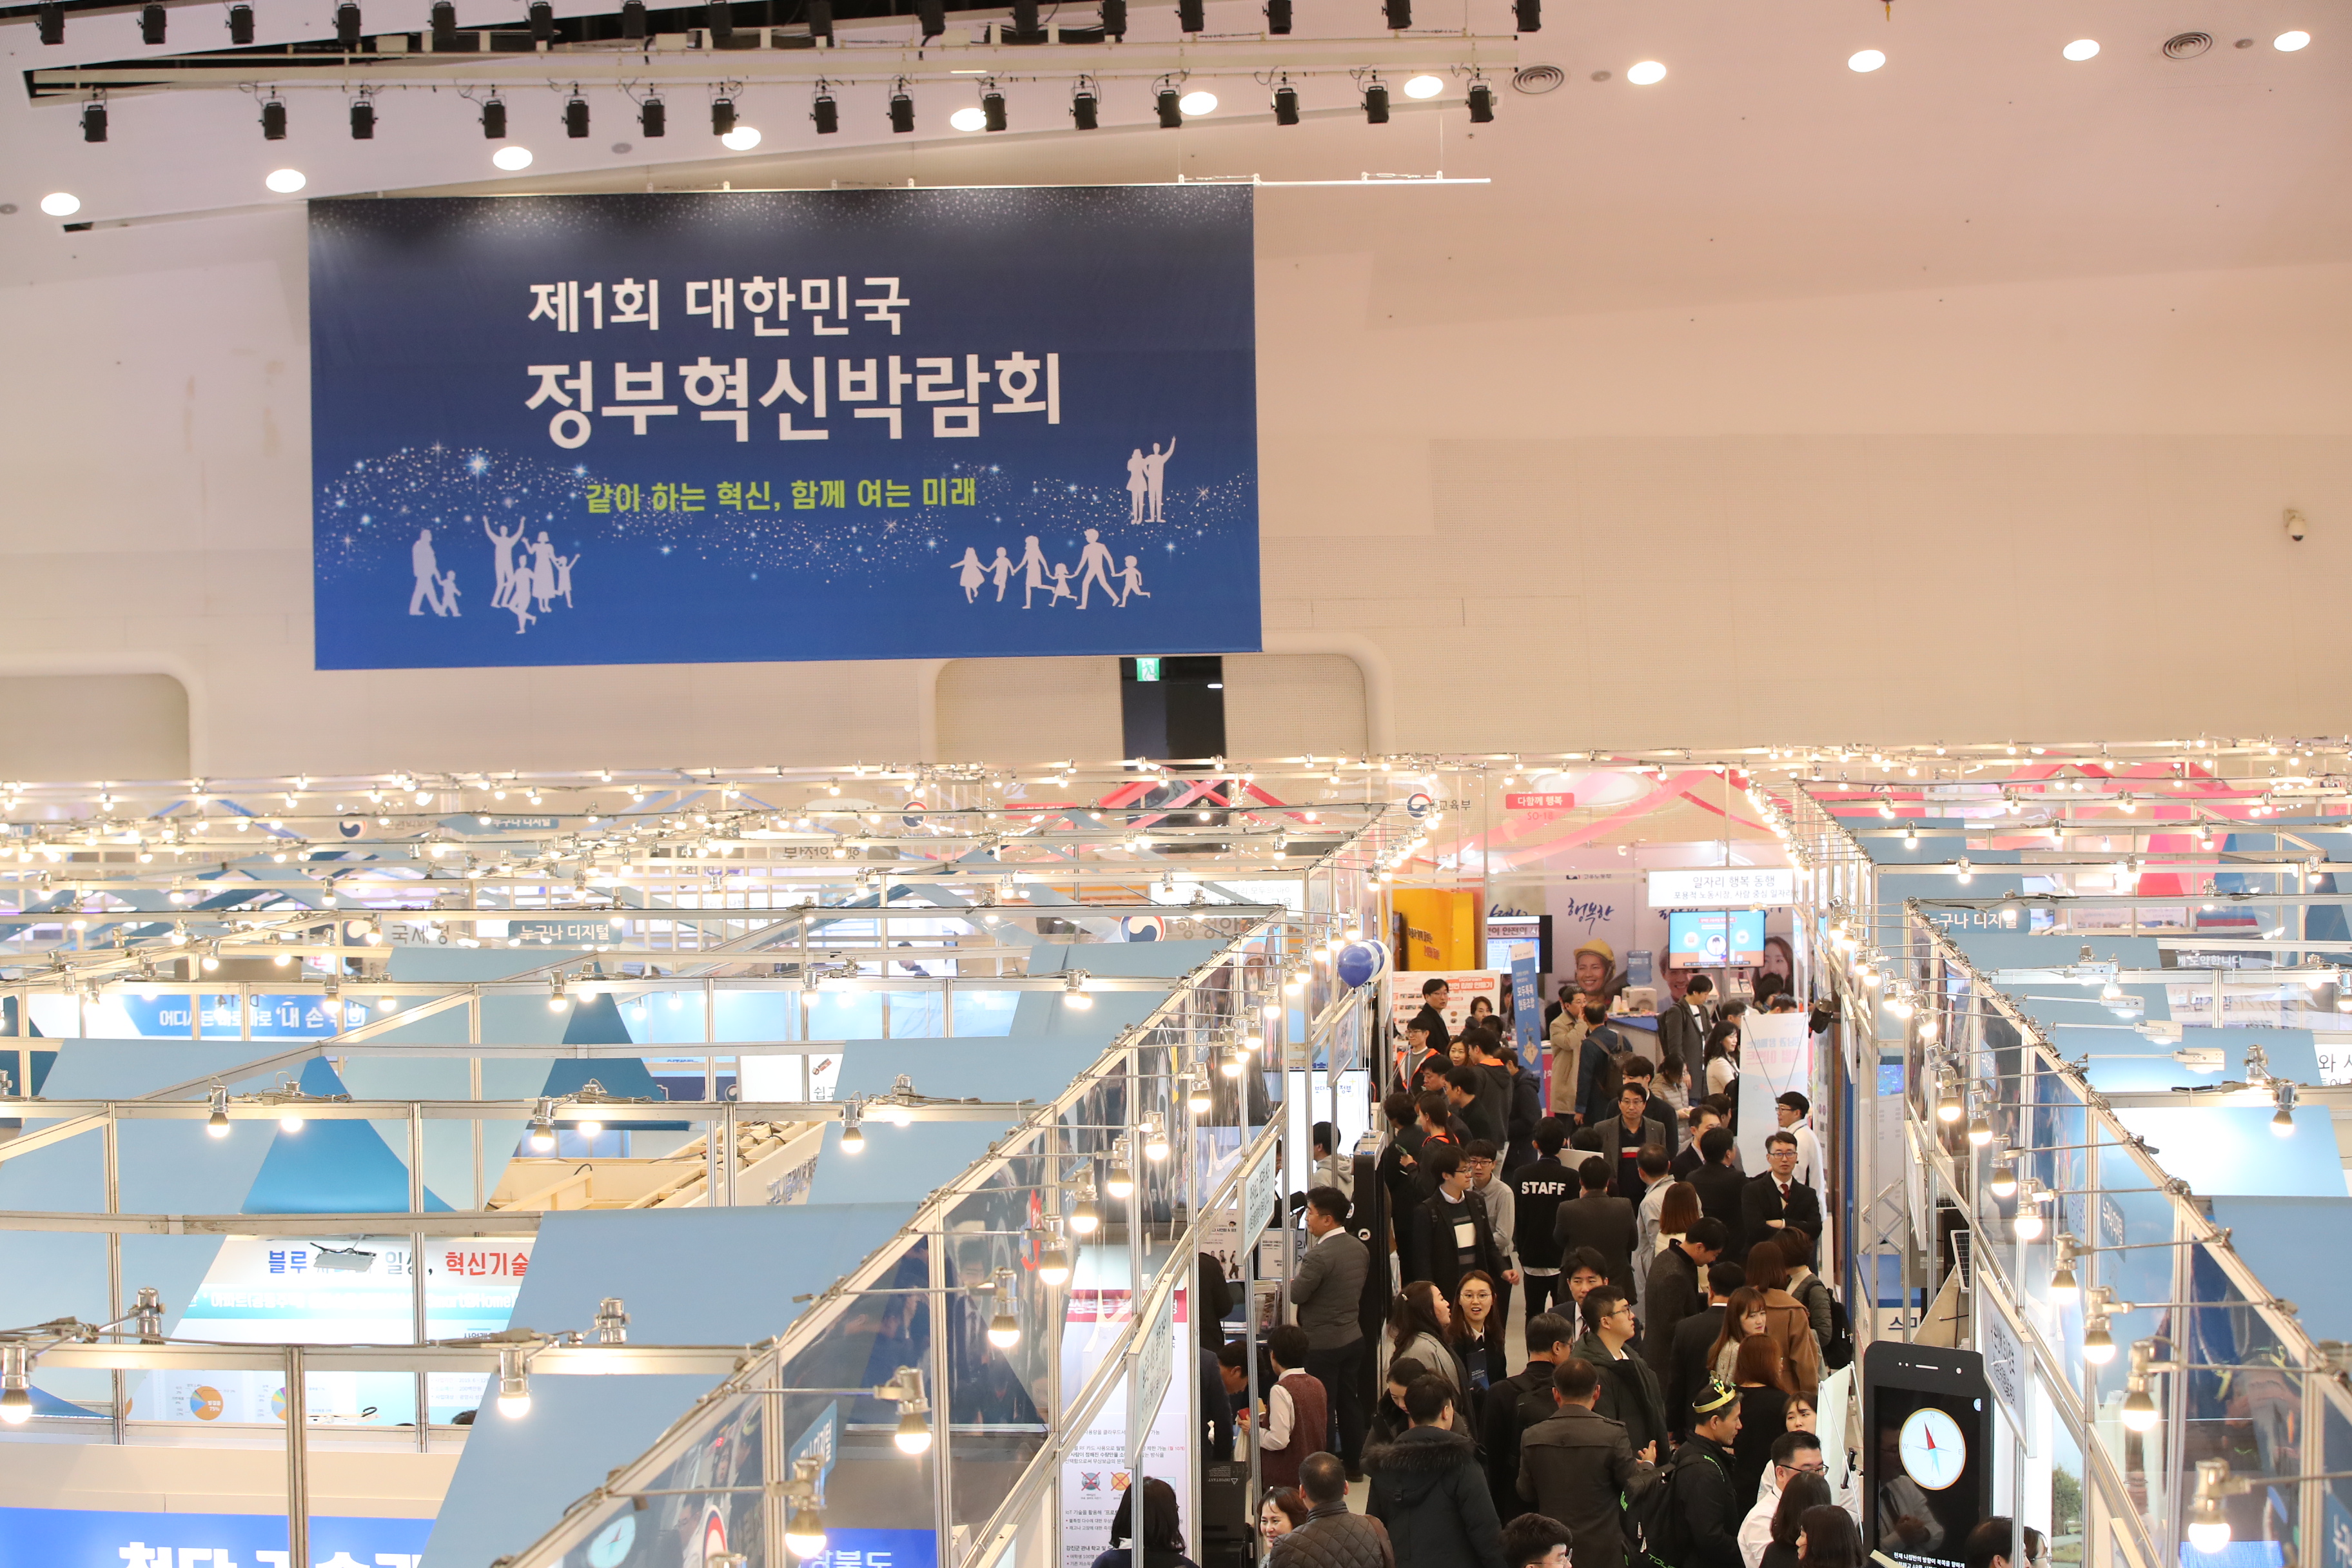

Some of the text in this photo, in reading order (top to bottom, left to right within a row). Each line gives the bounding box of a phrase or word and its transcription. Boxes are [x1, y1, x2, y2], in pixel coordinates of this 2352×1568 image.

[528, 275, 910, 337] 제1회 대한민국
[525, 351, 1061, 449] 정부혁신박람회
[586, 477, 976, 514] 같이 하는 혁신, 함께 여는 미래
[1518, 795, 1563, 807] 다함께 행복
[1692, 875, 1775, 888] 일자리 행복 동행
[1752, 890, 1768, 898] 중심
[520, 923, 611, 941] 누구나 디지털
[305, 1008, 325, 1028] 손
[1522, 1181, 1566, 1195] STAFF
[268, 1250, 308, 1275] 블루
[444, 1251, 529, 1277] 혁신기술
